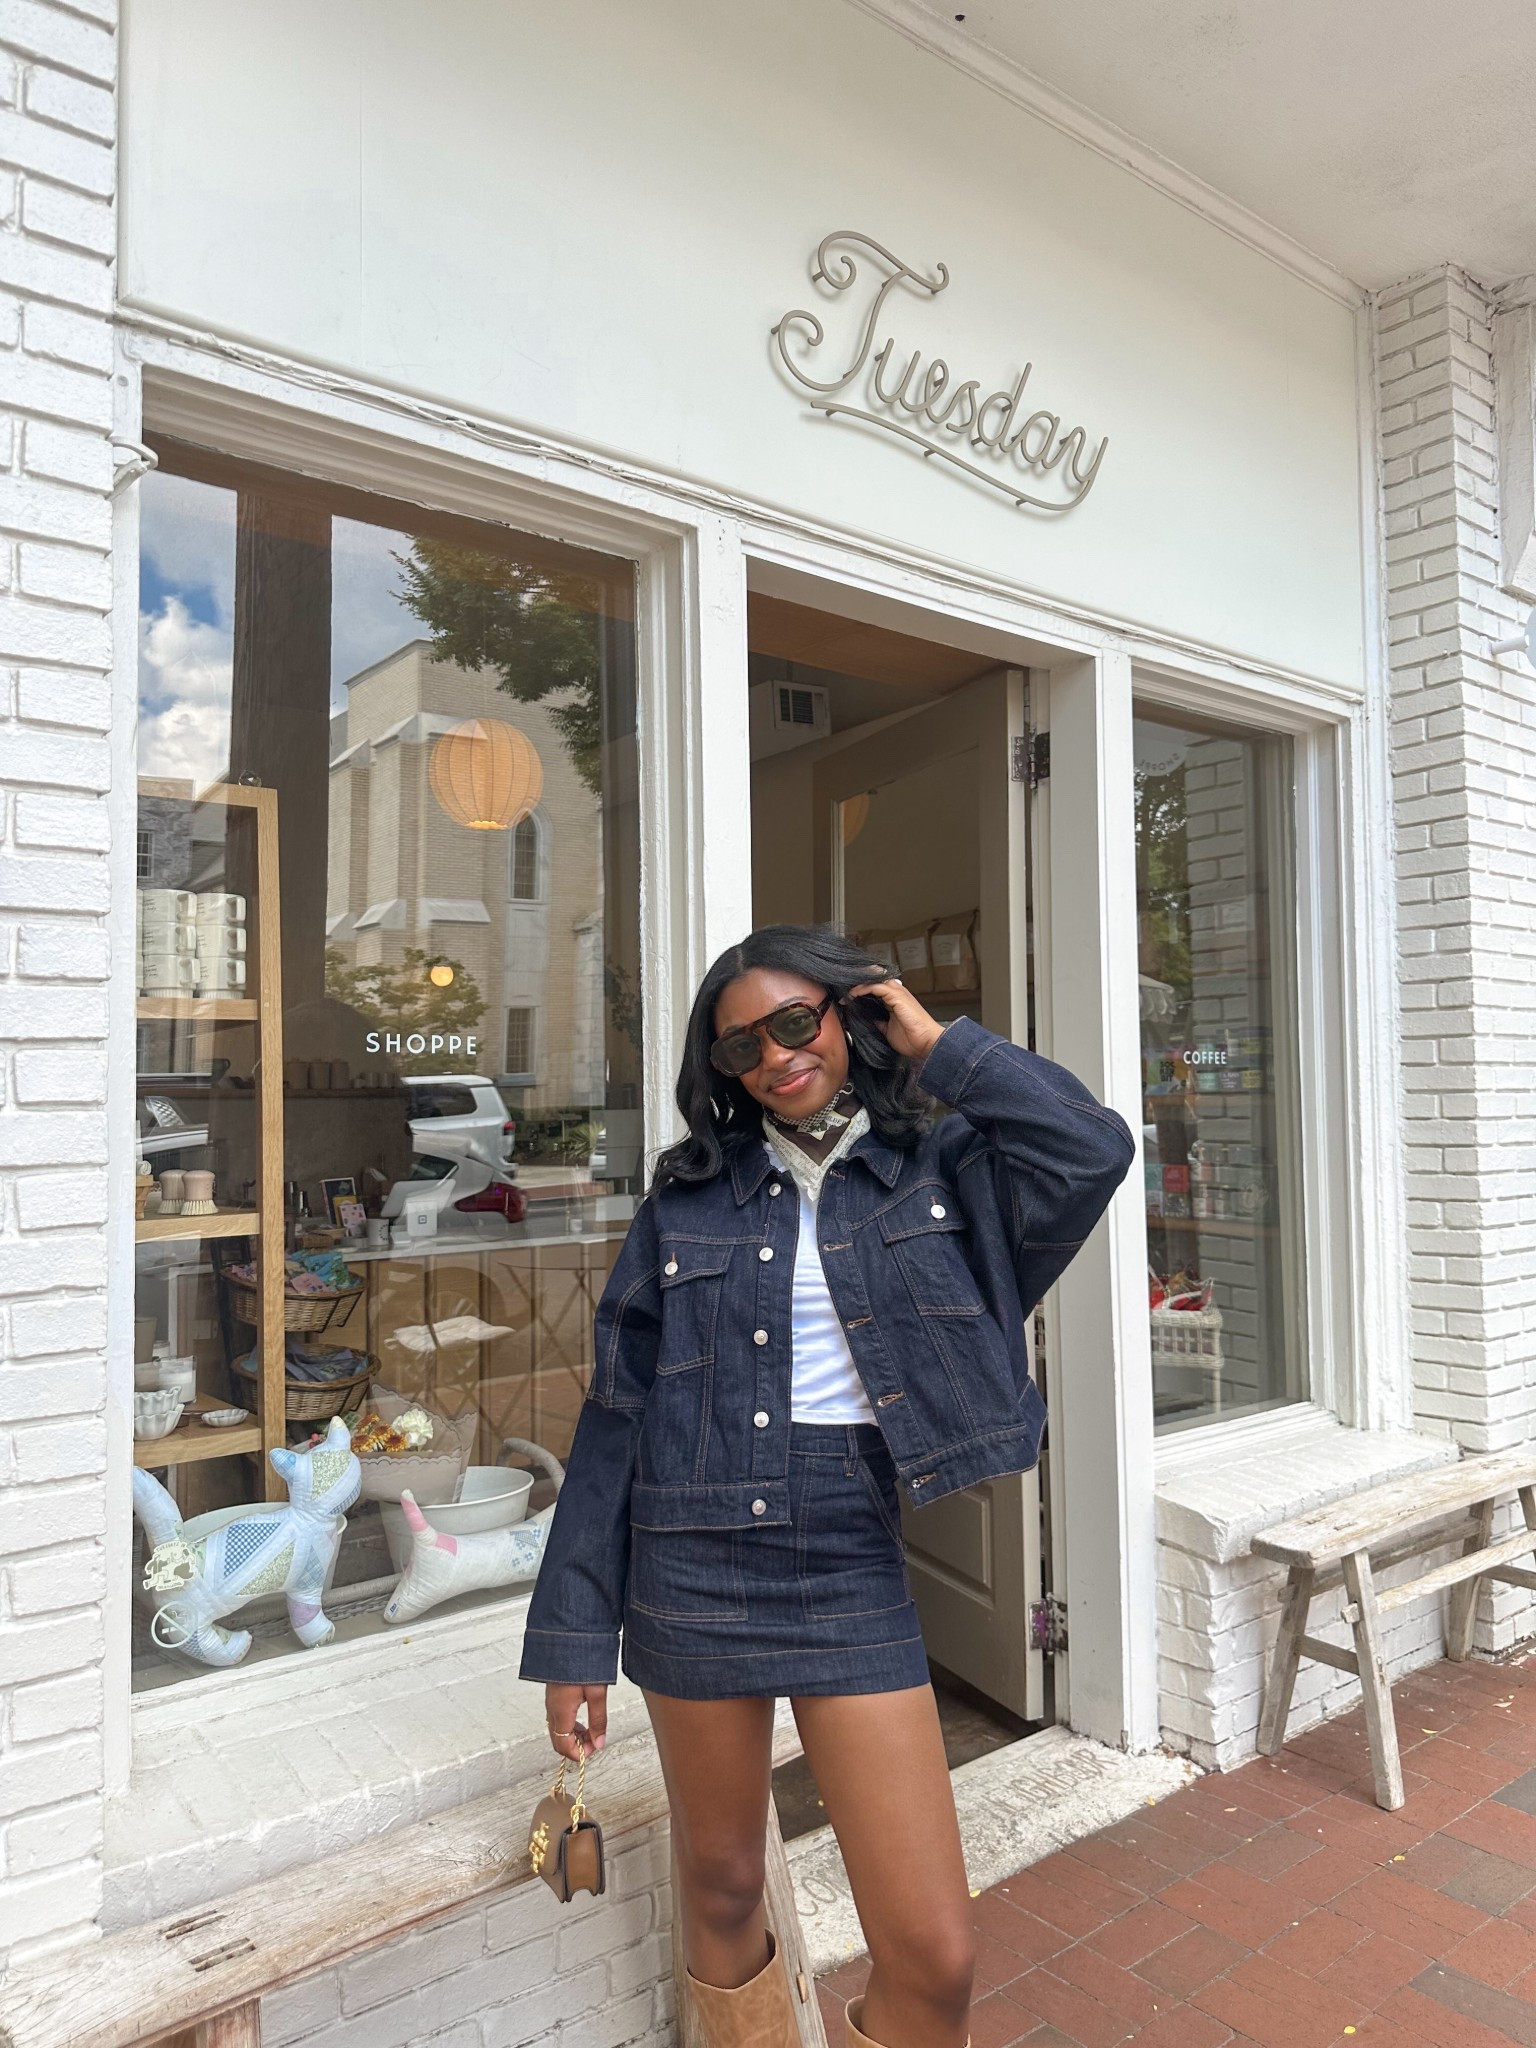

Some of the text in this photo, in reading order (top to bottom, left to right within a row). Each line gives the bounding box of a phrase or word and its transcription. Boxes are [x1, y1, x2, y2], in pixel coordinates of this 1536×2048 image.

[777, 230, 1109, 511] Tuesday
[366, 1032, 477, 1055] SHOPPE
[1183, 1050, 1228, 1065] COFFEE
